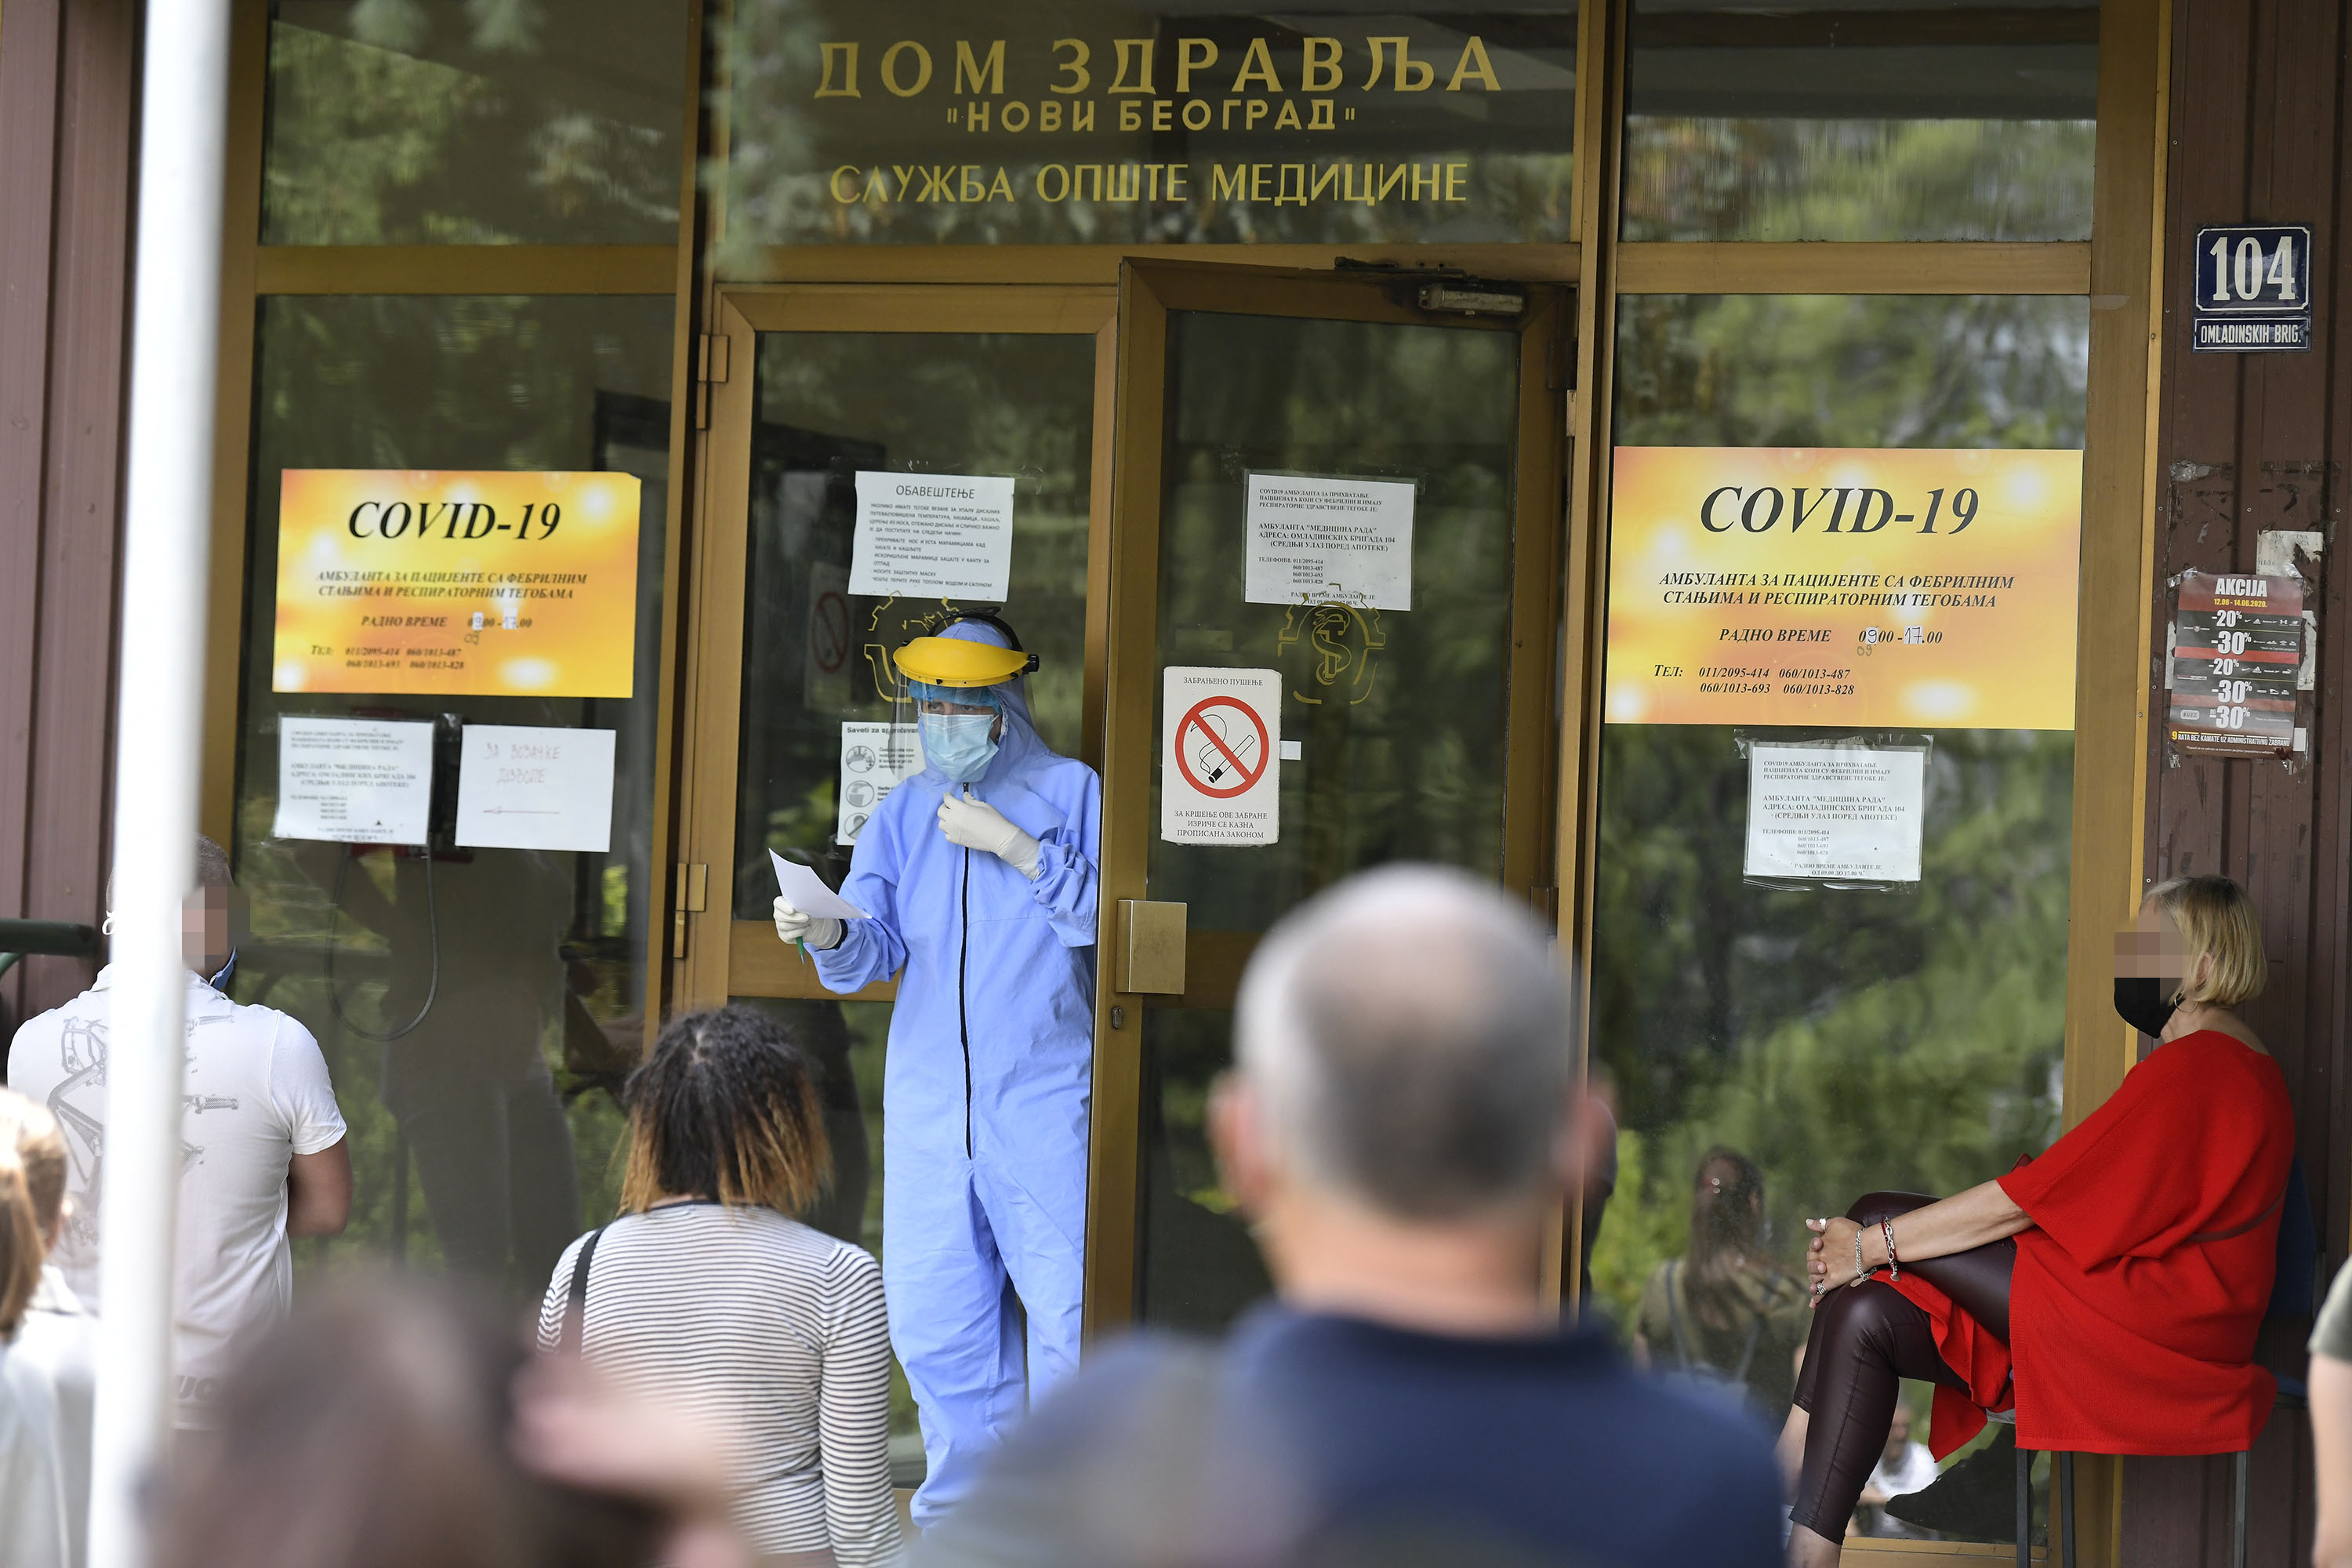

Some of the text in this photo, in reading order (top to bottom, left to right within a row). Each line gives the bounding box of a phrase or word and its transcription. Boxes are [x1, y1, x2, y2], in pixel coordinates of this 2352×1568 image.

[815, 35, 1502, 99] ДОМ ЗДРАВЉА
[948, 100, 1356, 132] "НОВИ БЕОГРАД"
[830, 162, 1467, 206] СЛУЖБА ОПШТЕ МЕДИЦИНЕ
[2210, 237, 2295, 300] 104
[2201, 325, 2301, 343] OMLADINSKIH BRIG.
[896, 485, 975, 499] ОБАВЕШТЕЊЕ
[1700, 486, 1979, 535] COVID-19
[348, 502, 561, 540] COVID-19
[316, 571, 587, 584] АМБУЛАНТА ЗА ПАЦИЈЕНТЕ СА ФЕБРИЛНИМ
[1660, 572, 2014, 590] АМБУЛАНТА ЗА ПАЦИЈЕНТЕ СА ФЕБРИЛНИМ
[318, 586, 574, 599] СТАЊИМА И РЕСПИРАТОРНИМ ТЕГОБАМА
[2215, 578, 2267, 597] AKCIJA
[1663, 591, 1996, 608] СТАЊИМА И РЕСПИРАТОРНИМ ТЕГОБАМА
[2234, 599, 2267, 608] 14.06.2020.
[361, 616, 403, 627] РАДНО
[405, 617, 447, 627] ВРЕМЕ
[2212, 610, 2242, 627] -20%
[1719, 629, 1774, 643] РАДНО
[1777, 629, 1831, 643] ВРЕМЕ
[2211, 630, 2252, 655] -30%
[1698, 666, 1769, 679] 011/2095-414
[1778, 668, 1850, 681] 060/1013-487
[2209, 658, 2239, 676] -20%
[1183, 677, 1229, 685] ЗАБРАЊЕНО
[1700, 682, 1855, 696] 060/1013-693 060/1013-828
[2212, 680, 2252, 704] -30%
[2172, 731, 2177, 740] 9
[2178, 732, 2190, 741] RATA
[2201, 734, 2220, 743] KAMATE
[2227, 735, 2267, 746] ADMINISTRATIVNU
[2269, 737, 2289, 746] ZABRANU
